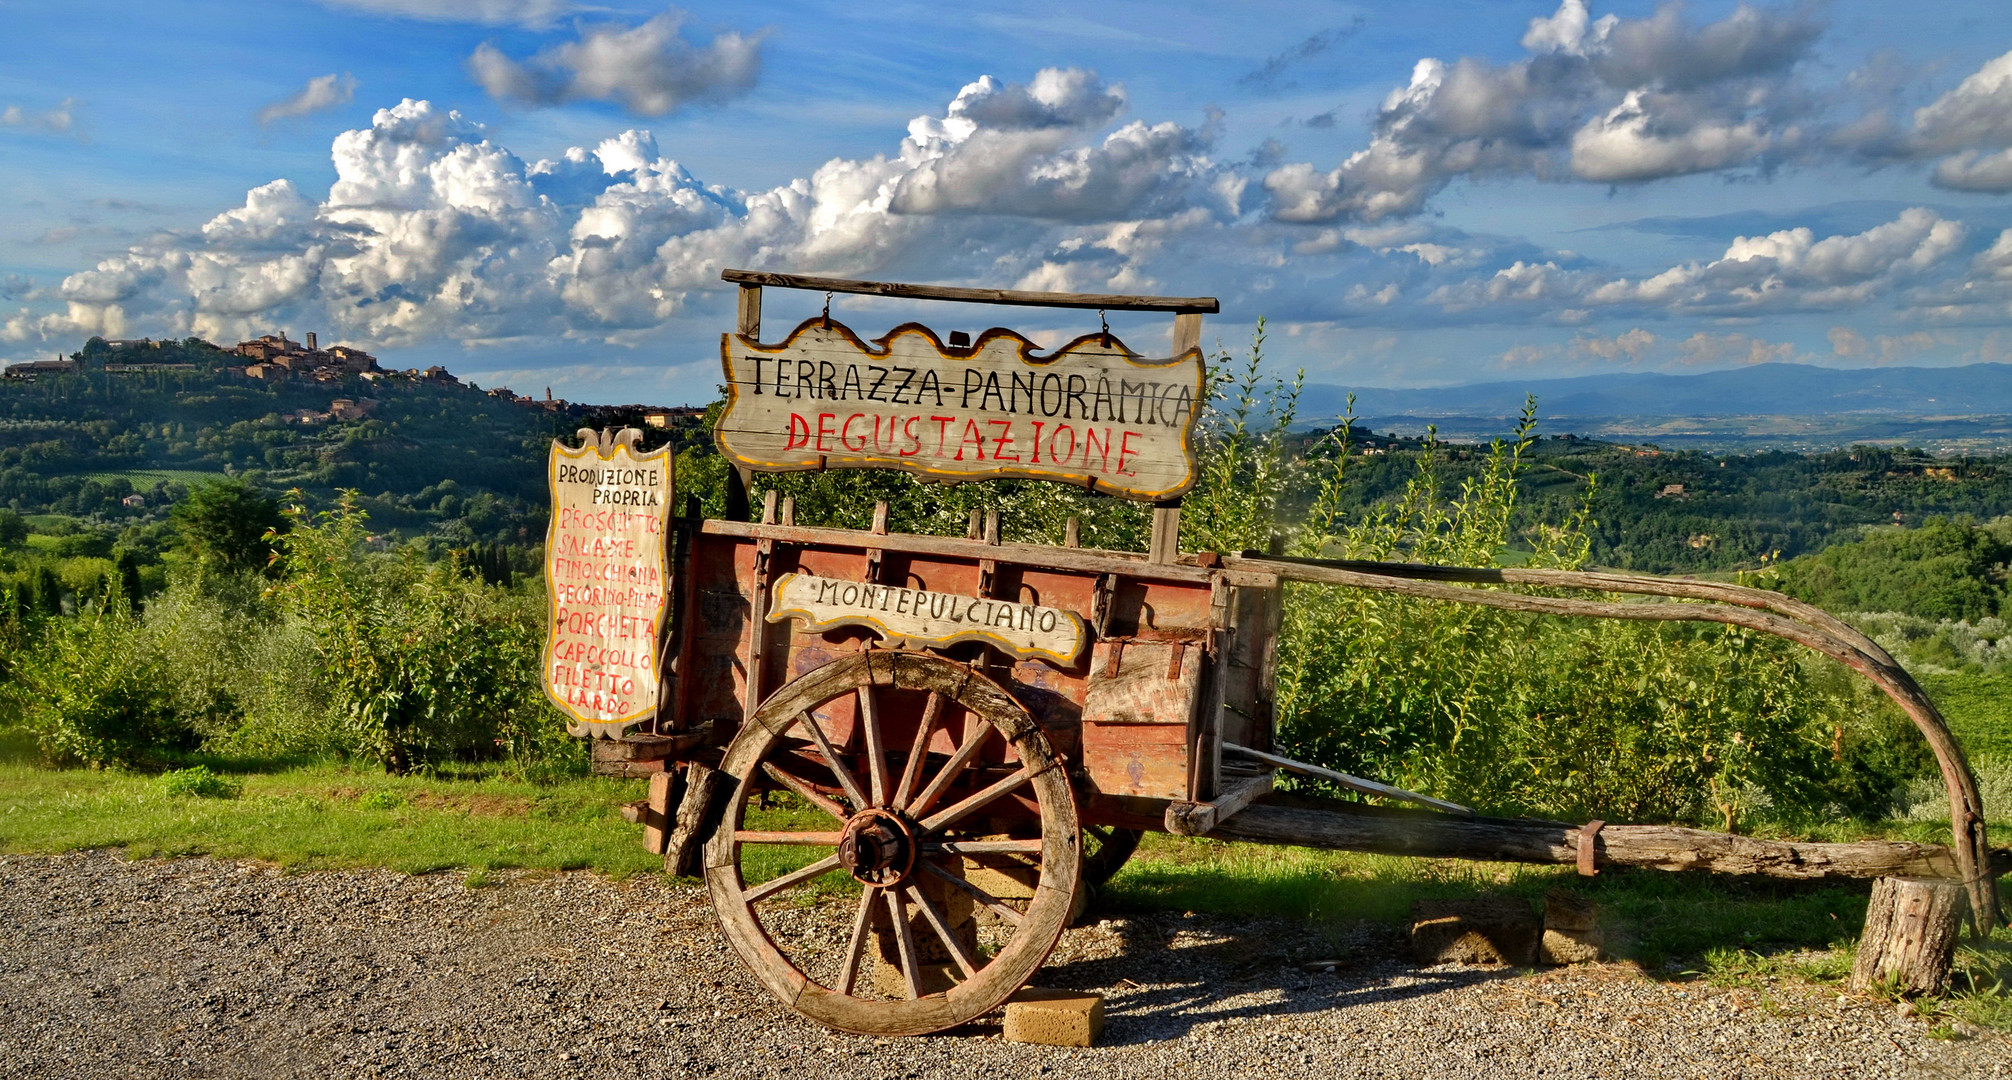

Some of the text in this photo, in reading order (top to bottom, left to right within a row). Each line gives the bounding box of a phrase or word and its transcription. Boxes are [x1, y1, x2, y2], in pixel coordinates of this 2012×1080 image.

[745, 356, 1193, 428] TERRAZZA-PANORAMICA
[783, 412, 1144, 478] DEGUSTAZIONE
[558, 464, 658, 487] PRODUZIONE
[592, 489, 658, 507] PROPRIA
[559, 507, 659, 534] PROSCIUTTO
[557, 533, 635, 559] SALAME
[554, 558, 661, 587] FINOCCHIONA
[815, 579, 1057, 633] MONTEPULCIANO
[556, 607, 656, 640] PORCHETTA
[553, 639, 652, 670] CAPOCOLLO
[553, 665, 635, 696] FILETTO
[567, 687, 630, 715] LARDO
